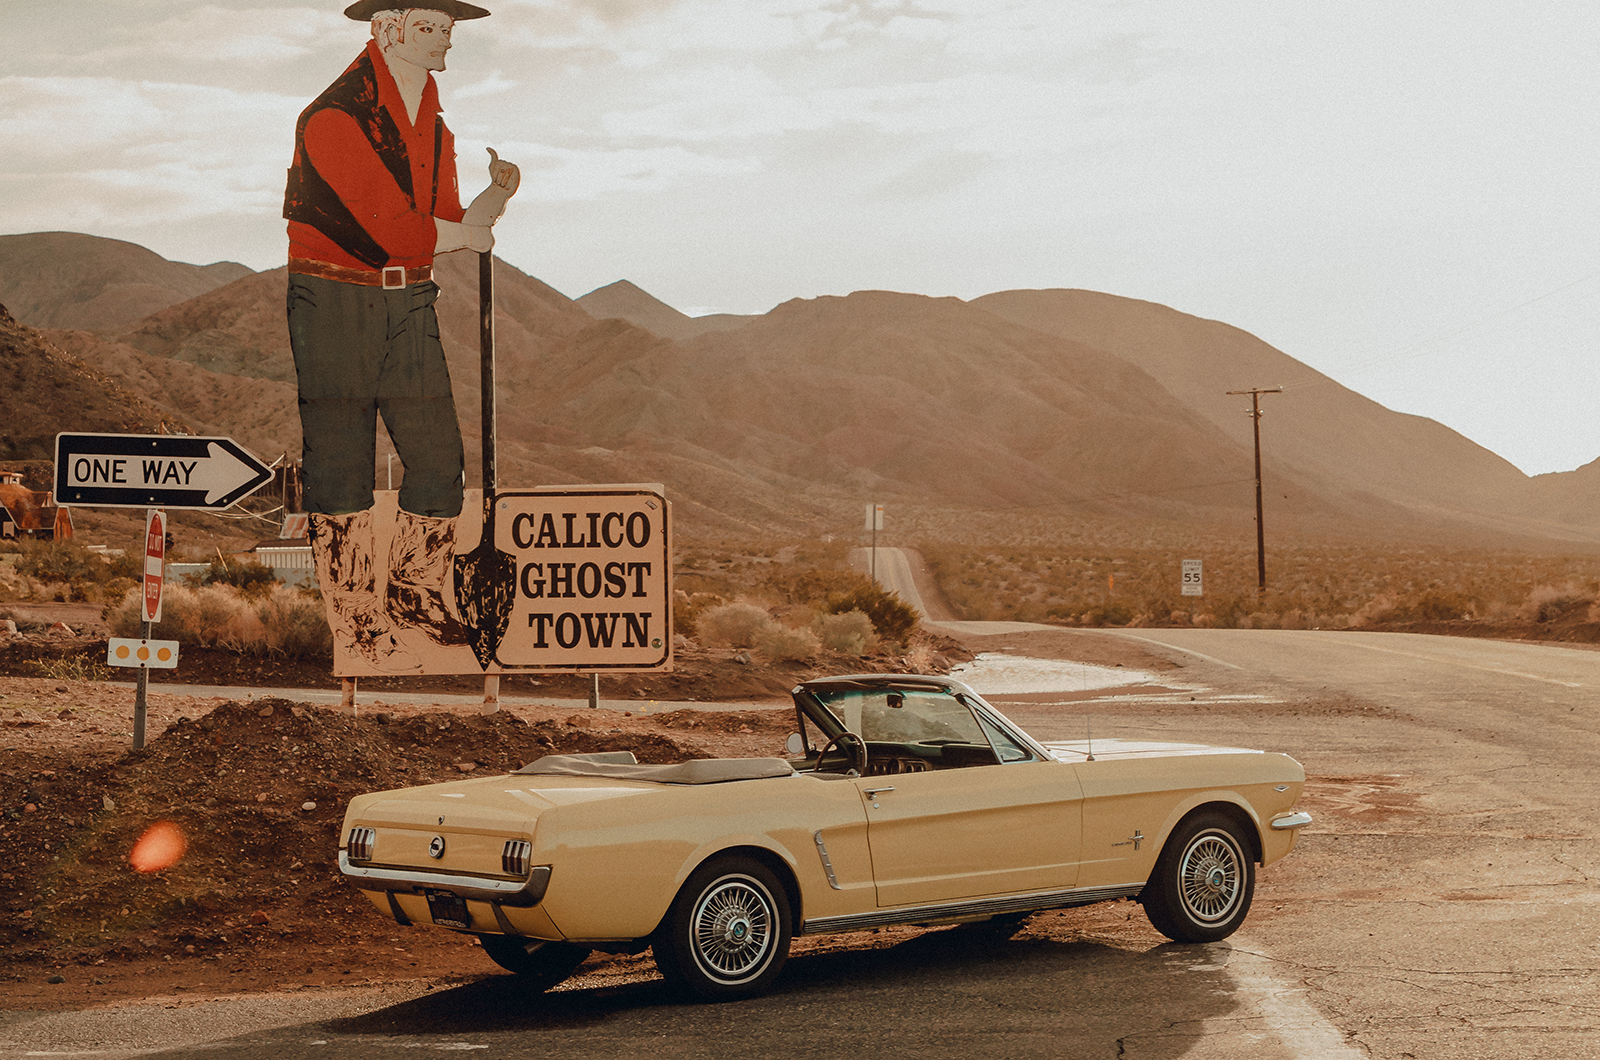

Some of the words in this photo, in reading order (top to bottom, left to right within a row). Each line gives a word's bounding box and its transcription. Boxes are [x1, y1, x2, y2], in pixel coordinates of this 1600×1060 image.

[74, 458, 127, 484] ONE
[142, 460, 198, 485] WAY
[149, 533, 154, 550] DO
[154, 534, 162, 552] NOT
[512, 511, 651, 549] CALICO
[147, 581, 159, 600] ENTER
[520, 561, 652, 599] GHOST
[1184, 573, 1201, 583] 55
[528, 611, 652, 650] TOWN
